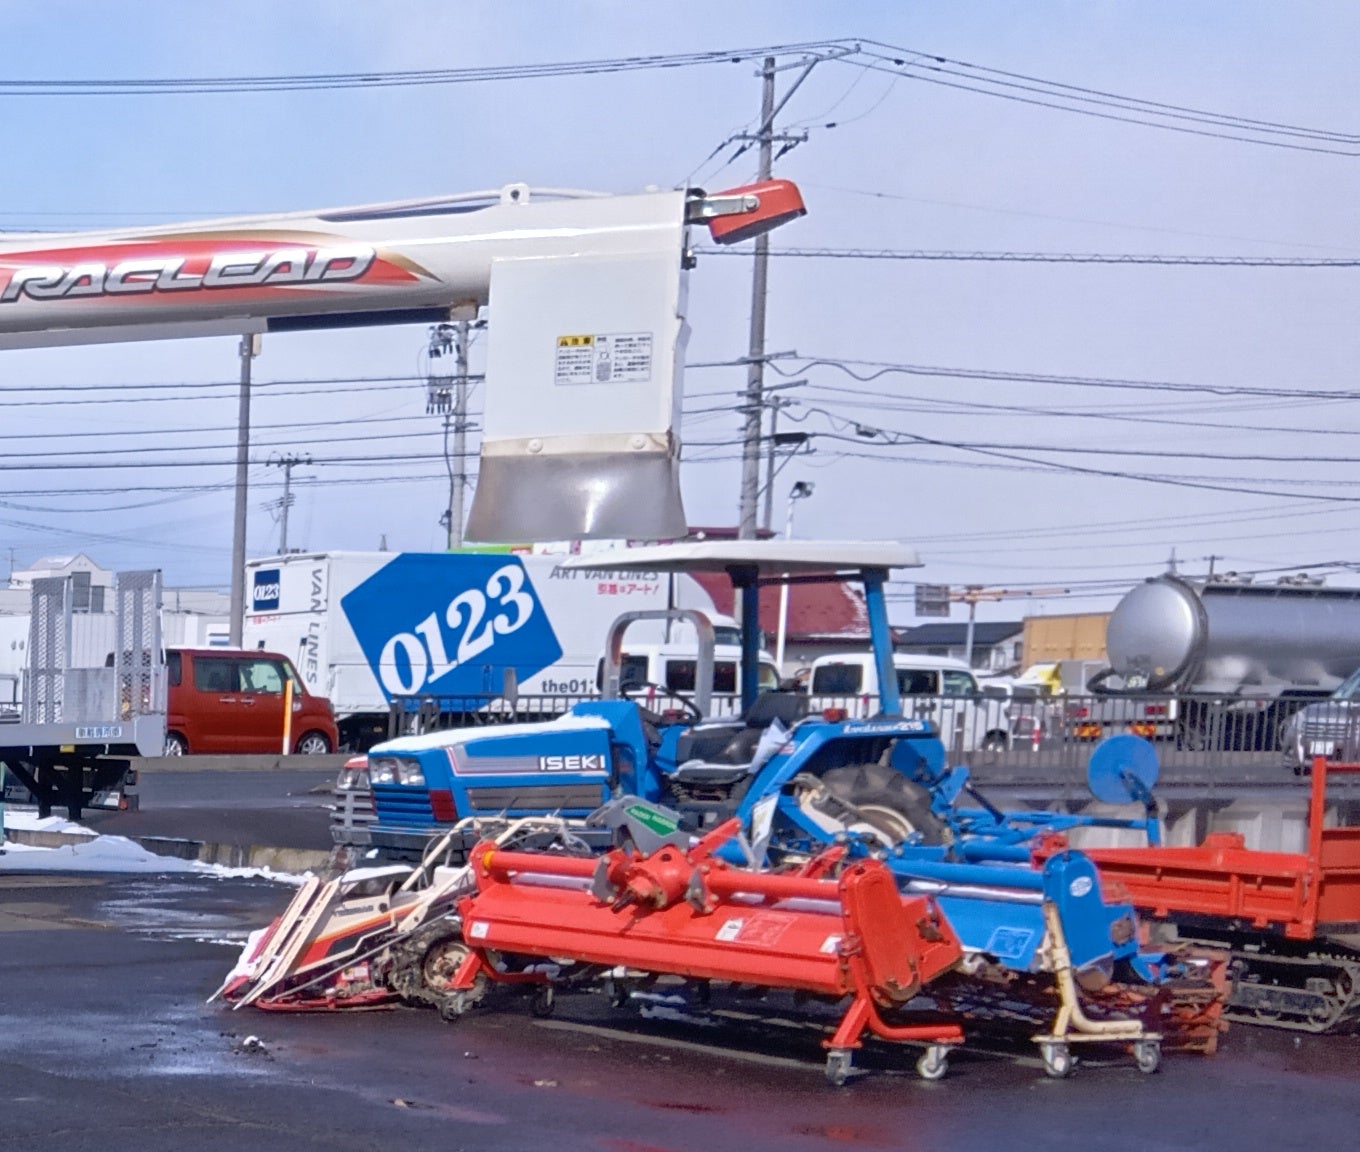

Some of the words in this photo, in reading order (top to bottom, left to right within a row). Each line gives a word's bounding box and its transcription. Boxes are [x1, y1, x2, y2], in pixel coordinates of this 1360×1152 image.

[0, 246, 376, 303] RACLEAD
[254, 583, 280, 601] 0123
[309, 568, 323, 616] VAN
[306, 622, 320, 684] LINES
[379, 564, 535, 696] 0123
[539, 755, 606, 771] ISEKI
